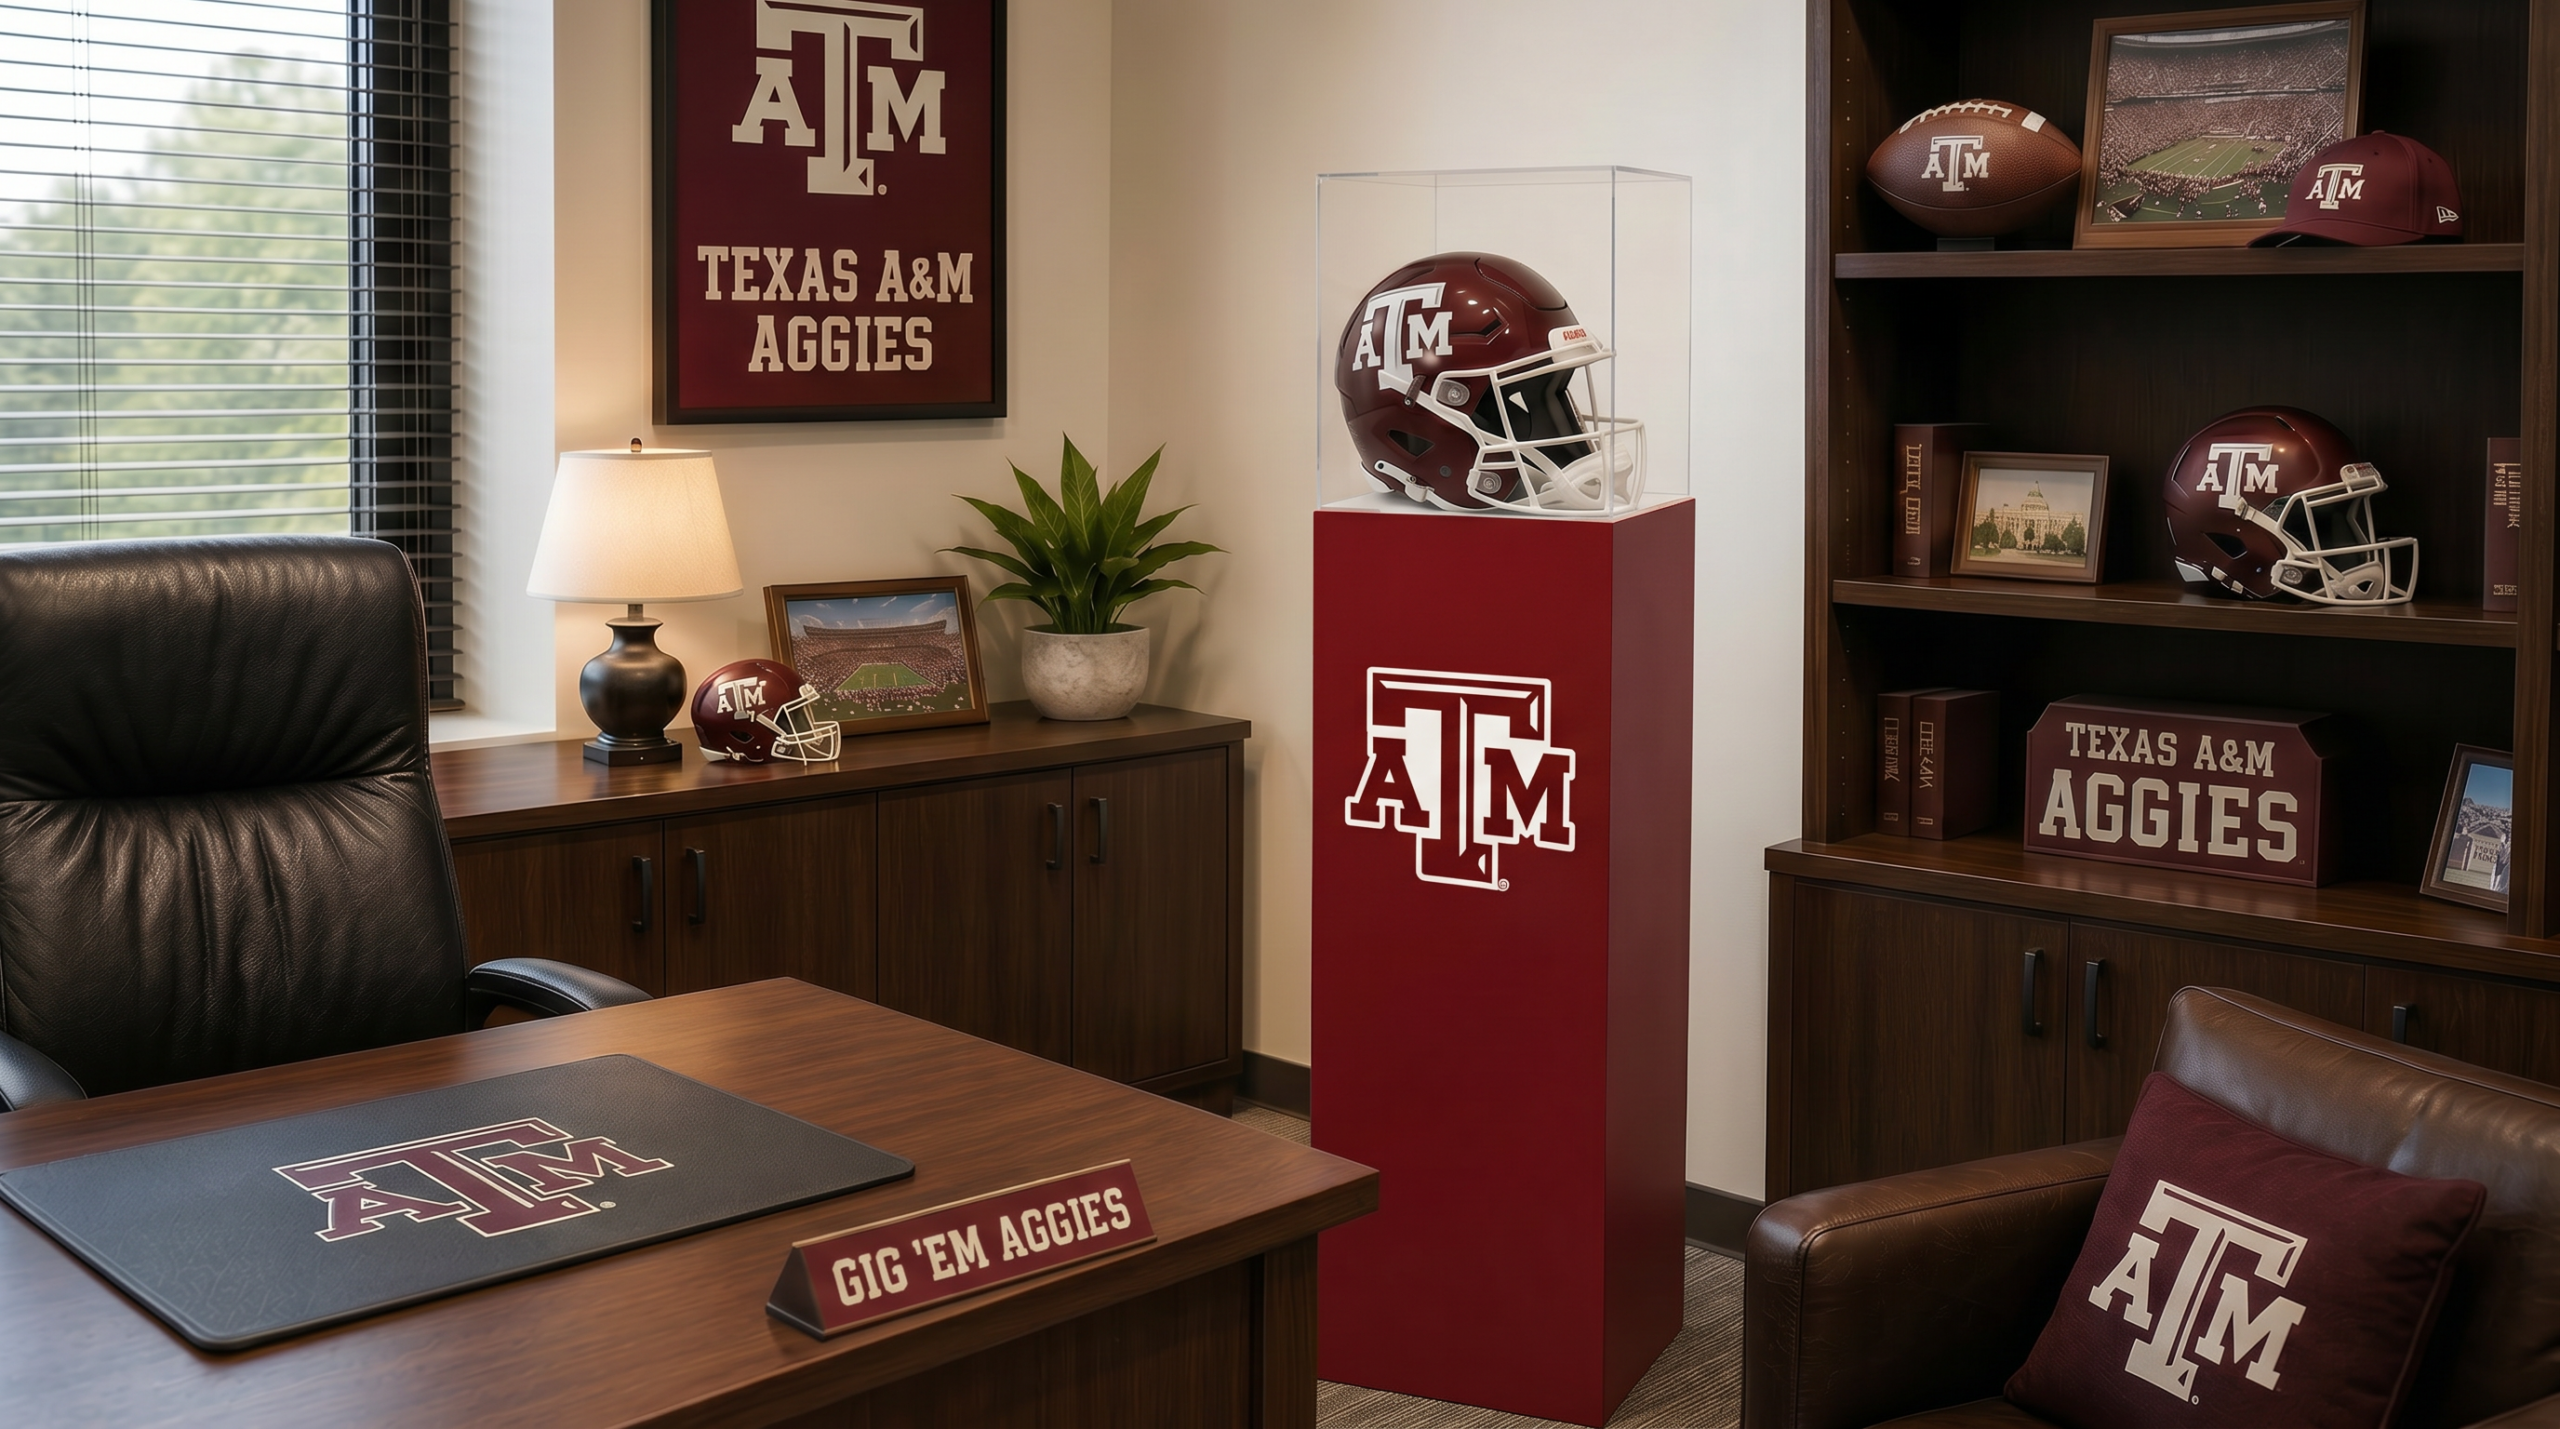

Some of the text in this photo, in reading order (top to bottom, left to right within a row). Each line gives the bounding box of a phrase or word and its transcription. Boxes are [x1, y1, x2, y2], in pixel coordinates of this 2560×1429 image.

[697, 245, 973, 303] TEXAS A&M
[748, 315, 933, 372] AGGIES
[2065, 721, 2275, 778] TEXAS A&M
[2039, 768, 2298, 863] AGGIES
[831, 1187, 1132, 1306] GIG 'EM AGGIES
